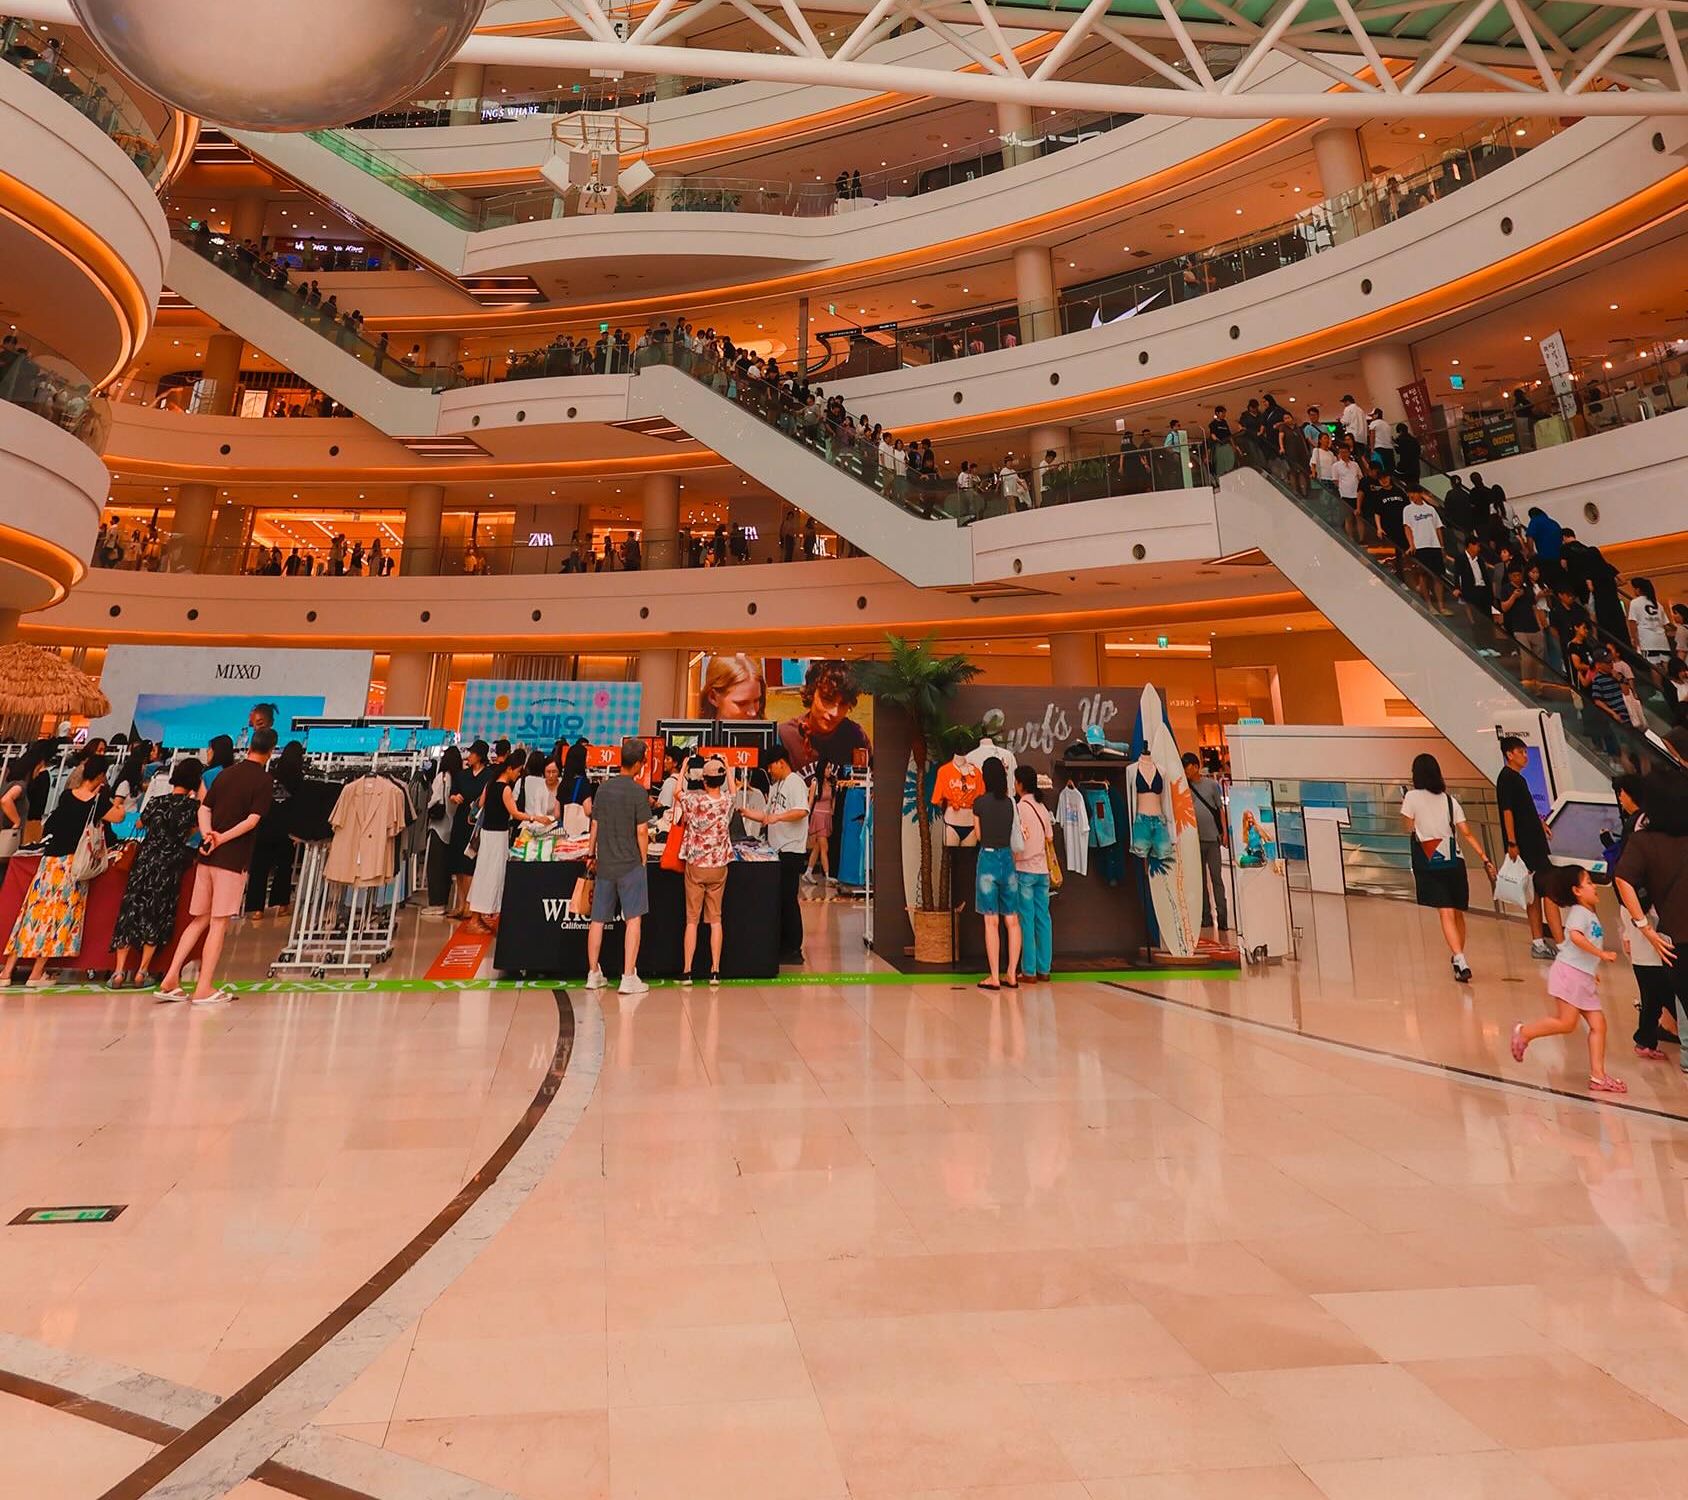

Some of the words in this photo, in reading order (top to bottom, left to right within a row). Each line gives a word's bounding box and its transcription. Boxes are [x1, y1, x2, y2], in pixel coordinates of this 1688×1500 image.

[480, 107, 505, 119] ING'S
[528, 532, 554, 547] ZARA
[215, 663, 262, 680] MIXXO
[1078, 692, 1119, 735] Up
[516, 713, 584, 740] 스파오
[221, 981, 378, 993] MIXXO
